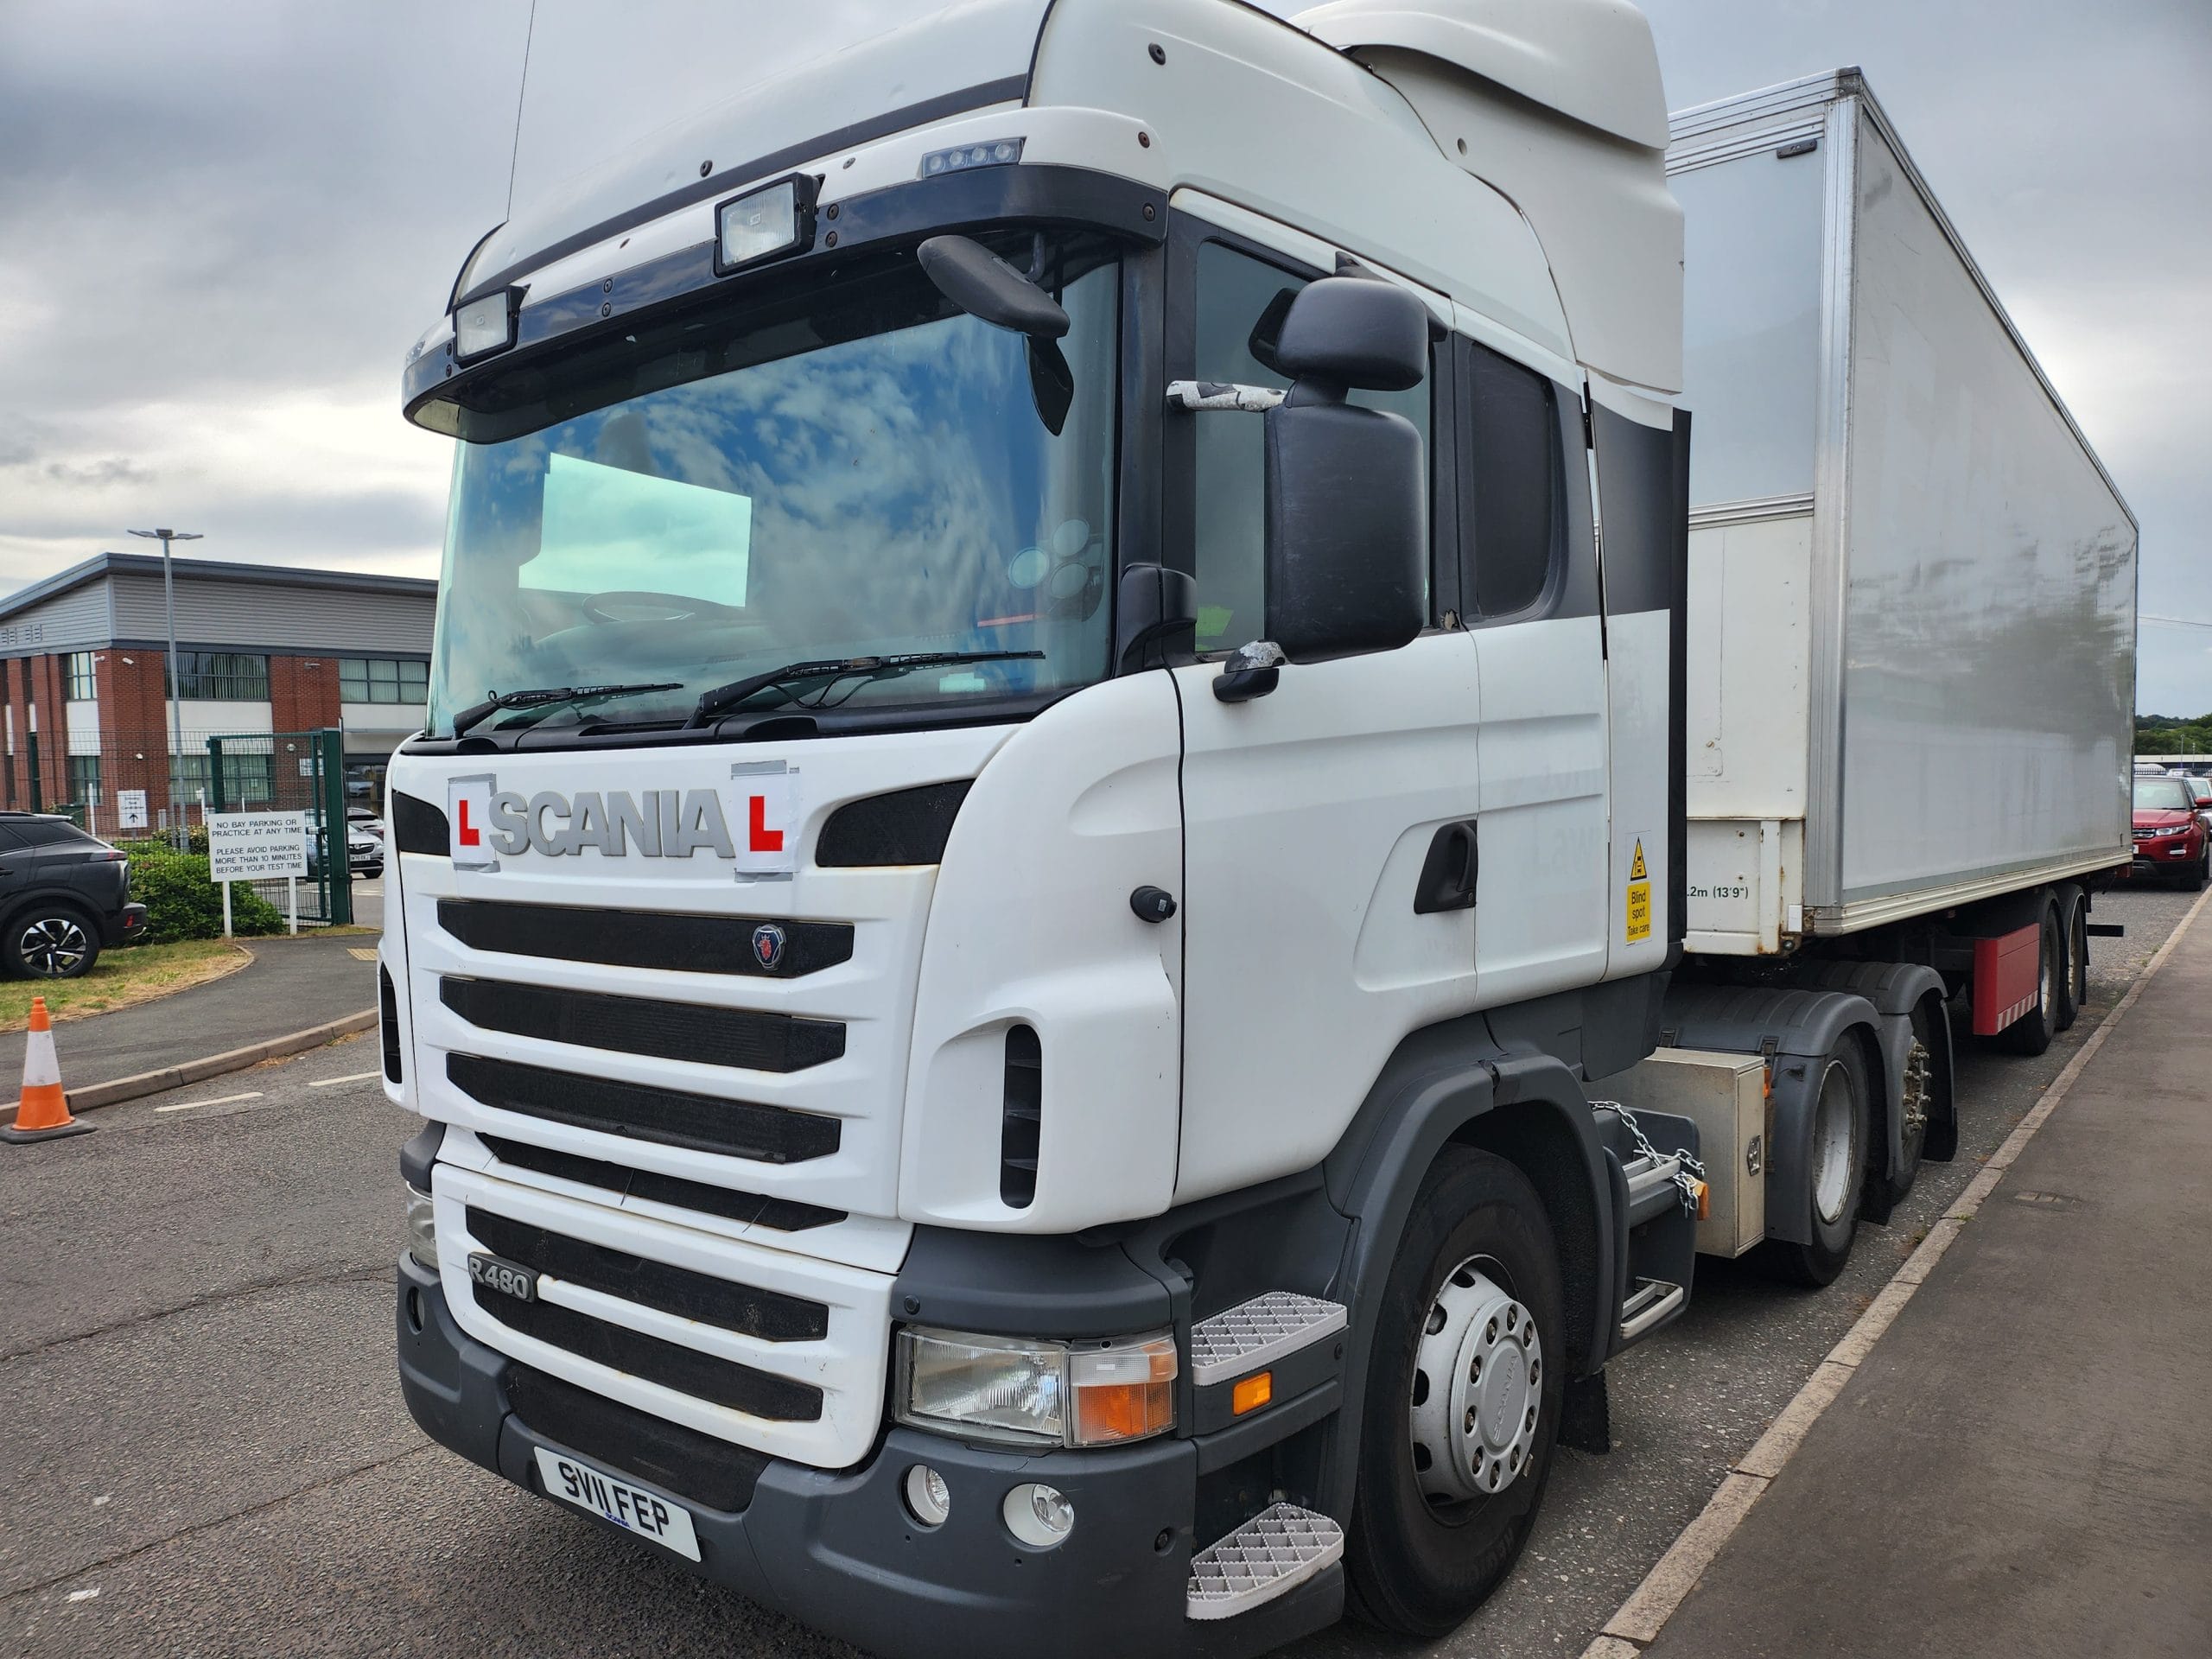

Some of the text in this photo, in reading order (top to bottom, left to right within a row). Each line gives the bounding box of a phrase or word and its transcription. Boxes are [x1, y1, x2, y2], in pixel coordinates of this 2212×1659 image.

[459, 799, 480, 846] L
[488, 789, 736, 858] SCANIA
[749, 796, 784, 852] L
[1631, 889, 1646, 905] Blind
[1687, 887, 1707, 897] .2m
[1627, 924, 1650, 936] Take care
[1632, 906, 1645, 922] spot
[469, 1257, 529, 1300] R480
[612, 1484, 670, 1536] FEP
